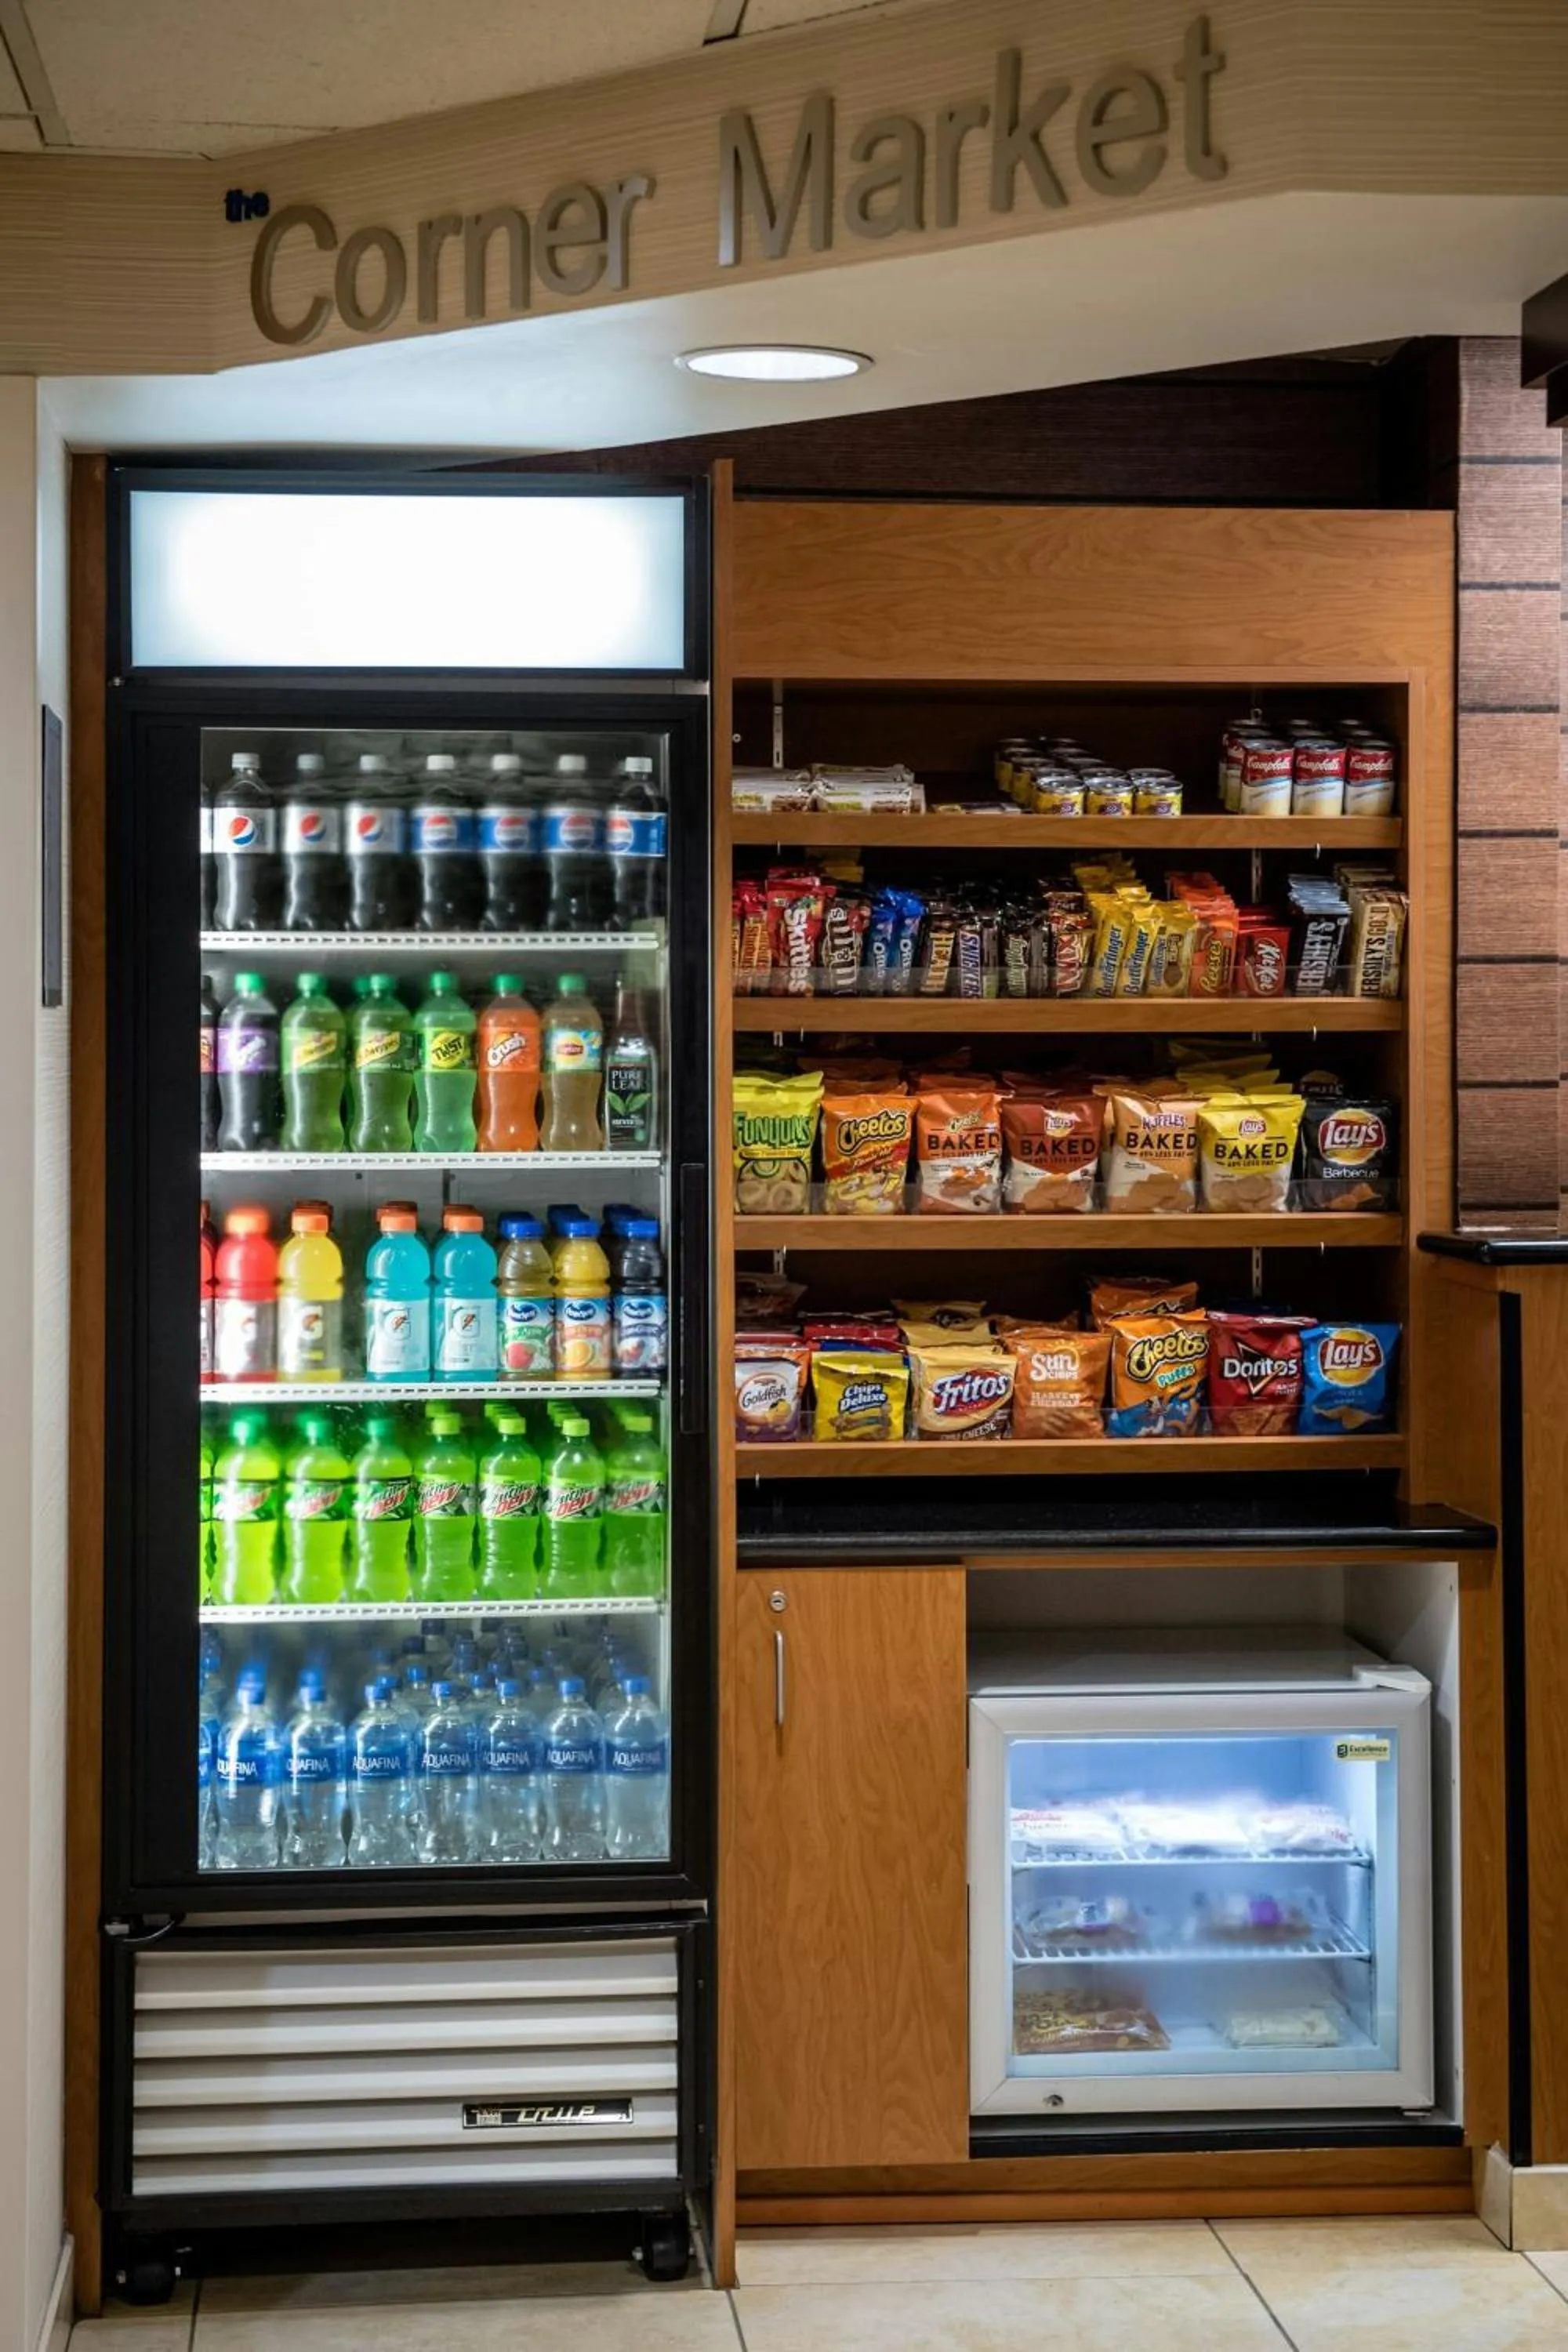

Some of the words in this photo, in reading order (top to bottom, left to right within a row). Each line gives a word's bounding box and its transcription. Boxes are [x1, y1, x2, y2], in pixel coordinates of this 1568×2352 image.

[249, 173, 657, 347] Corner
[717, 14, 1229, 268] Market
[224, 187, 271, 223] the
[784, 908, 813, 993] Skittles
[839, 1110, 907, 1155] Cheetos
[927, 1133, 1000, 1151] BAKED
[1127, 1133, 1197, 1150] BAKED
[1324, 1120, 1380, 1150] Lay's
[1021, 1138, 1095, 1156] BAKED
[1214, 1142, 1288, 1160] BAKED
[1323, 1167, 1381, 1179] Barbecue
[1128, 1333, 1207, 1377] Cheetos
[1324, 1341, 1376, 1370] Lay's
[1156, 1364, 1196, 1388] Puffs
[1223, 1357, 1298, 1378] Doritos
[742, 1385, 788, 1409] Goldfish
[844, 1382, 883, 1398] Chips
[931, 1372, 1009, 1413] Fritos
[840, 1392, 887, 1412] Deluxe
[353, 1756, 401, 1771] AQUAFINA
[422, 1753, 470, 1767] AQUAFINA
[483, 1751, 529, 1765] AQUAFINA
[547, 1748, 594, 1764] AQUAFINA
[613, 1751, 661, 1766] AQUAFINA
